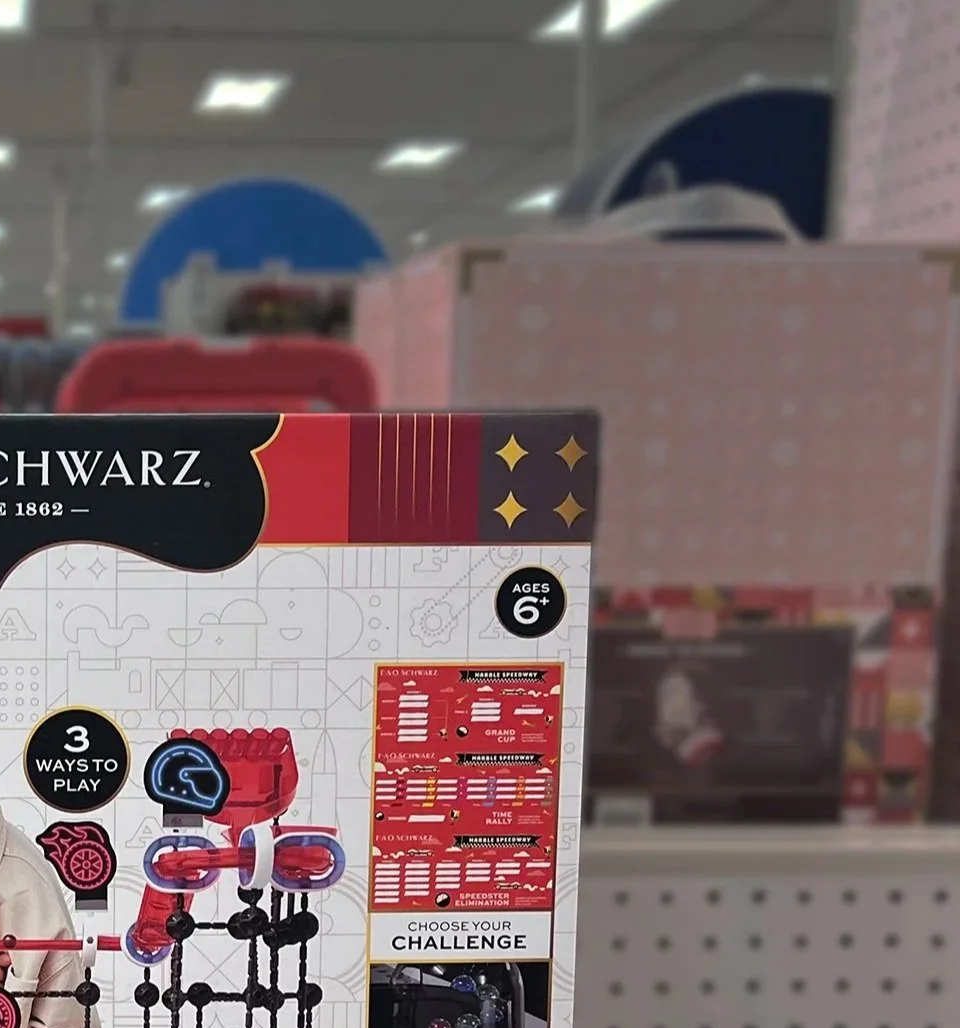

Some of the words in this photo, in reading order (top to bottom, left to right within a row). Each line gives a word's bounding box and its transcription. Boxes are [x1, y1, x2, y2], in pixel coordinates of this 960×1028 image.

[15, 501, 64, 517] 1862
[512, 583, 550, 594] AGES
[513, 595, 550, 625] 6+
[63, 725, 90, 753] 3
[35, 758, 89, 772] WAYS
[92, 758, 118, 772] TO
[53, 779, 101, 792] PLAY
[459, 892, 510, 900] SPEEDSTER
[455, 899, 510, 907] ELIMINATION
[408, 921, 469, 932] CHOOSE
[472, 921, 512, 931] YOUR
[391, 935, 527, 951] CHALLENGE
